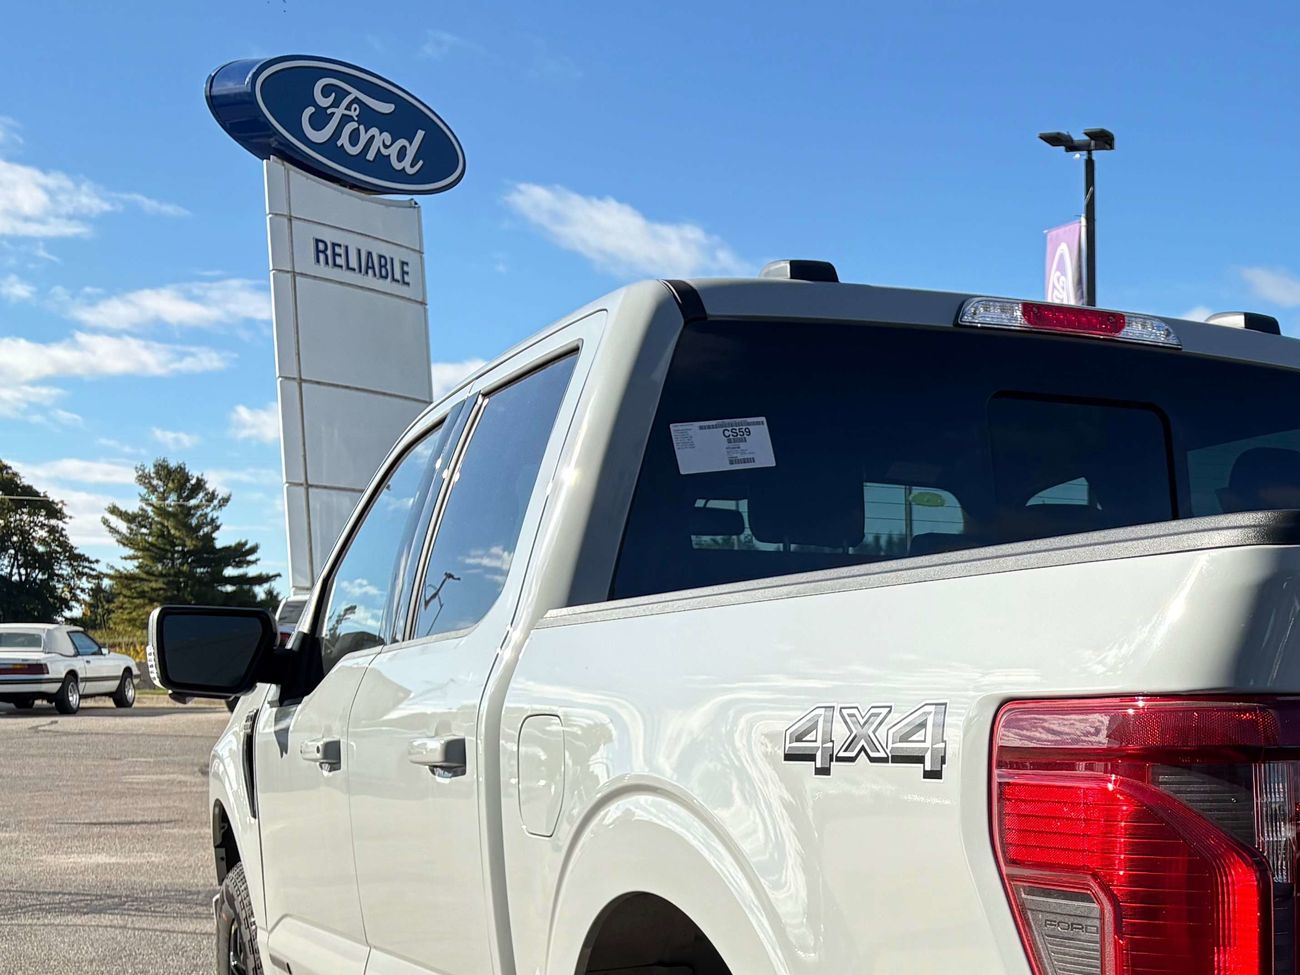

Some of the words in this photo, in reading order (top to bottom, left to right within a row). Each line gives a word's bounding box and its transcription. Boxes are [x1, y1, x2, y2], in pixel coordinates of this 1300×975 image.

[301, 77, 426, 175] Ford
[313, 237, 411, 287] RELIABLE
[722, 427, 752, 439] CS59
[1044, 918, 1099, 935] FORD
